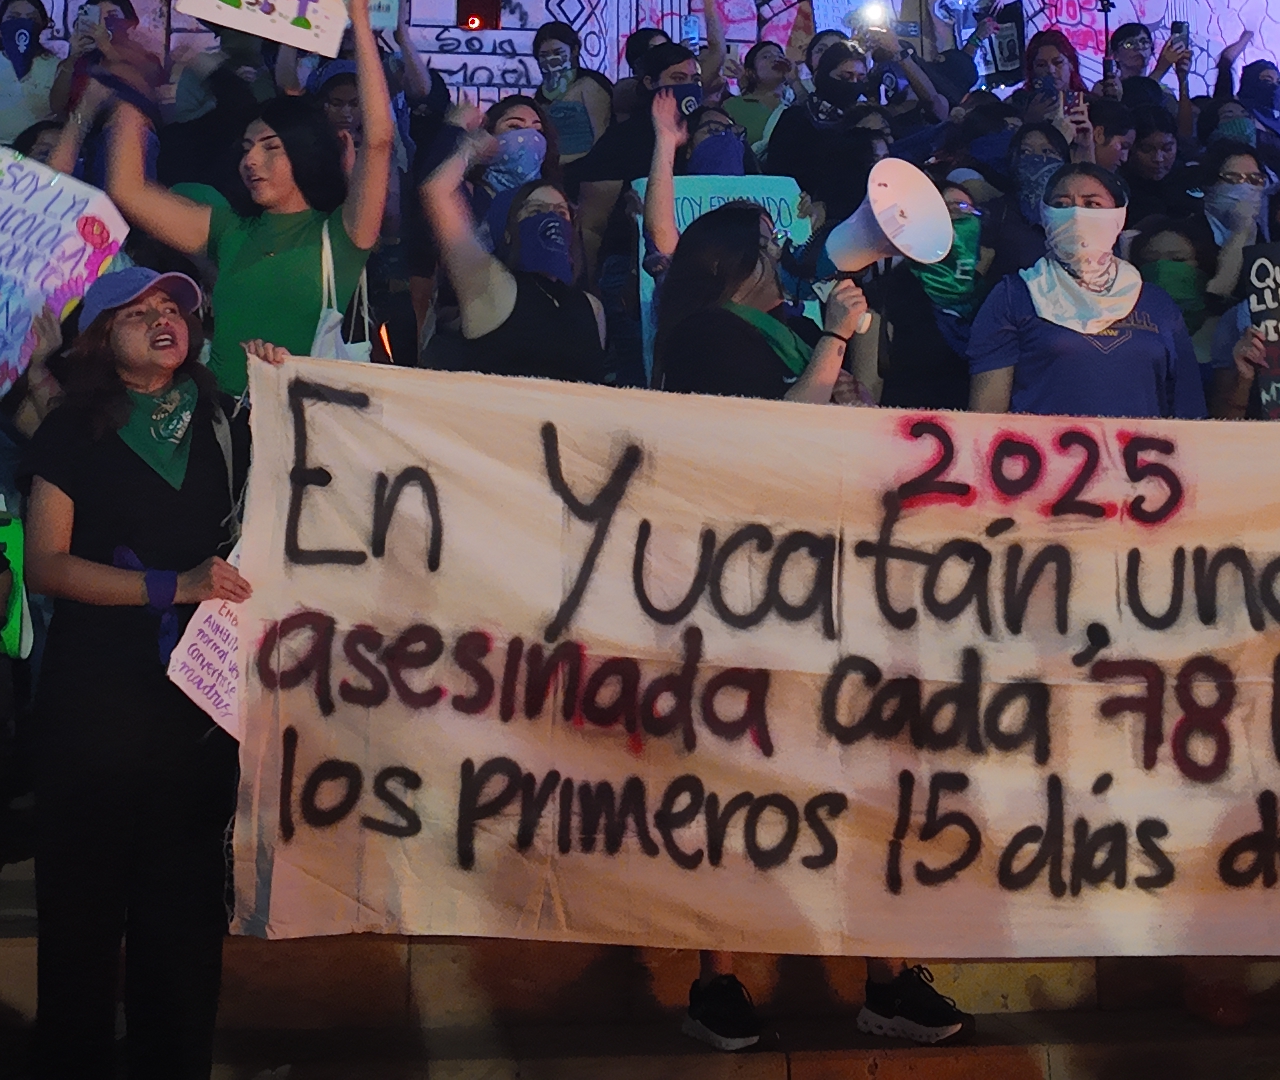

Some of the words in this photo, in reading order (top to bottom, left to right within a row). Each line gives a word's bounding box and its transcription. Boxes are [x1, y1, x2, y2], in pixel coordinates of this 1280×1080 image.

[43, 186, 90, 222] LA
[286, 377, 442, 573] En
[539, 421, 1110, 668] Yucatán,
[896, 418, 1185, 526] 2025
[257, 610, 774, 758] asesinada
[819, 645, 1053, 766] cada
[1088, 656, 1238, 786] 78
[276, 725, 423, 843] los
[455, 756, 849, 872] primeros
[883, 769, 985, 897] 15
[996, 771, 1176, 900] días
